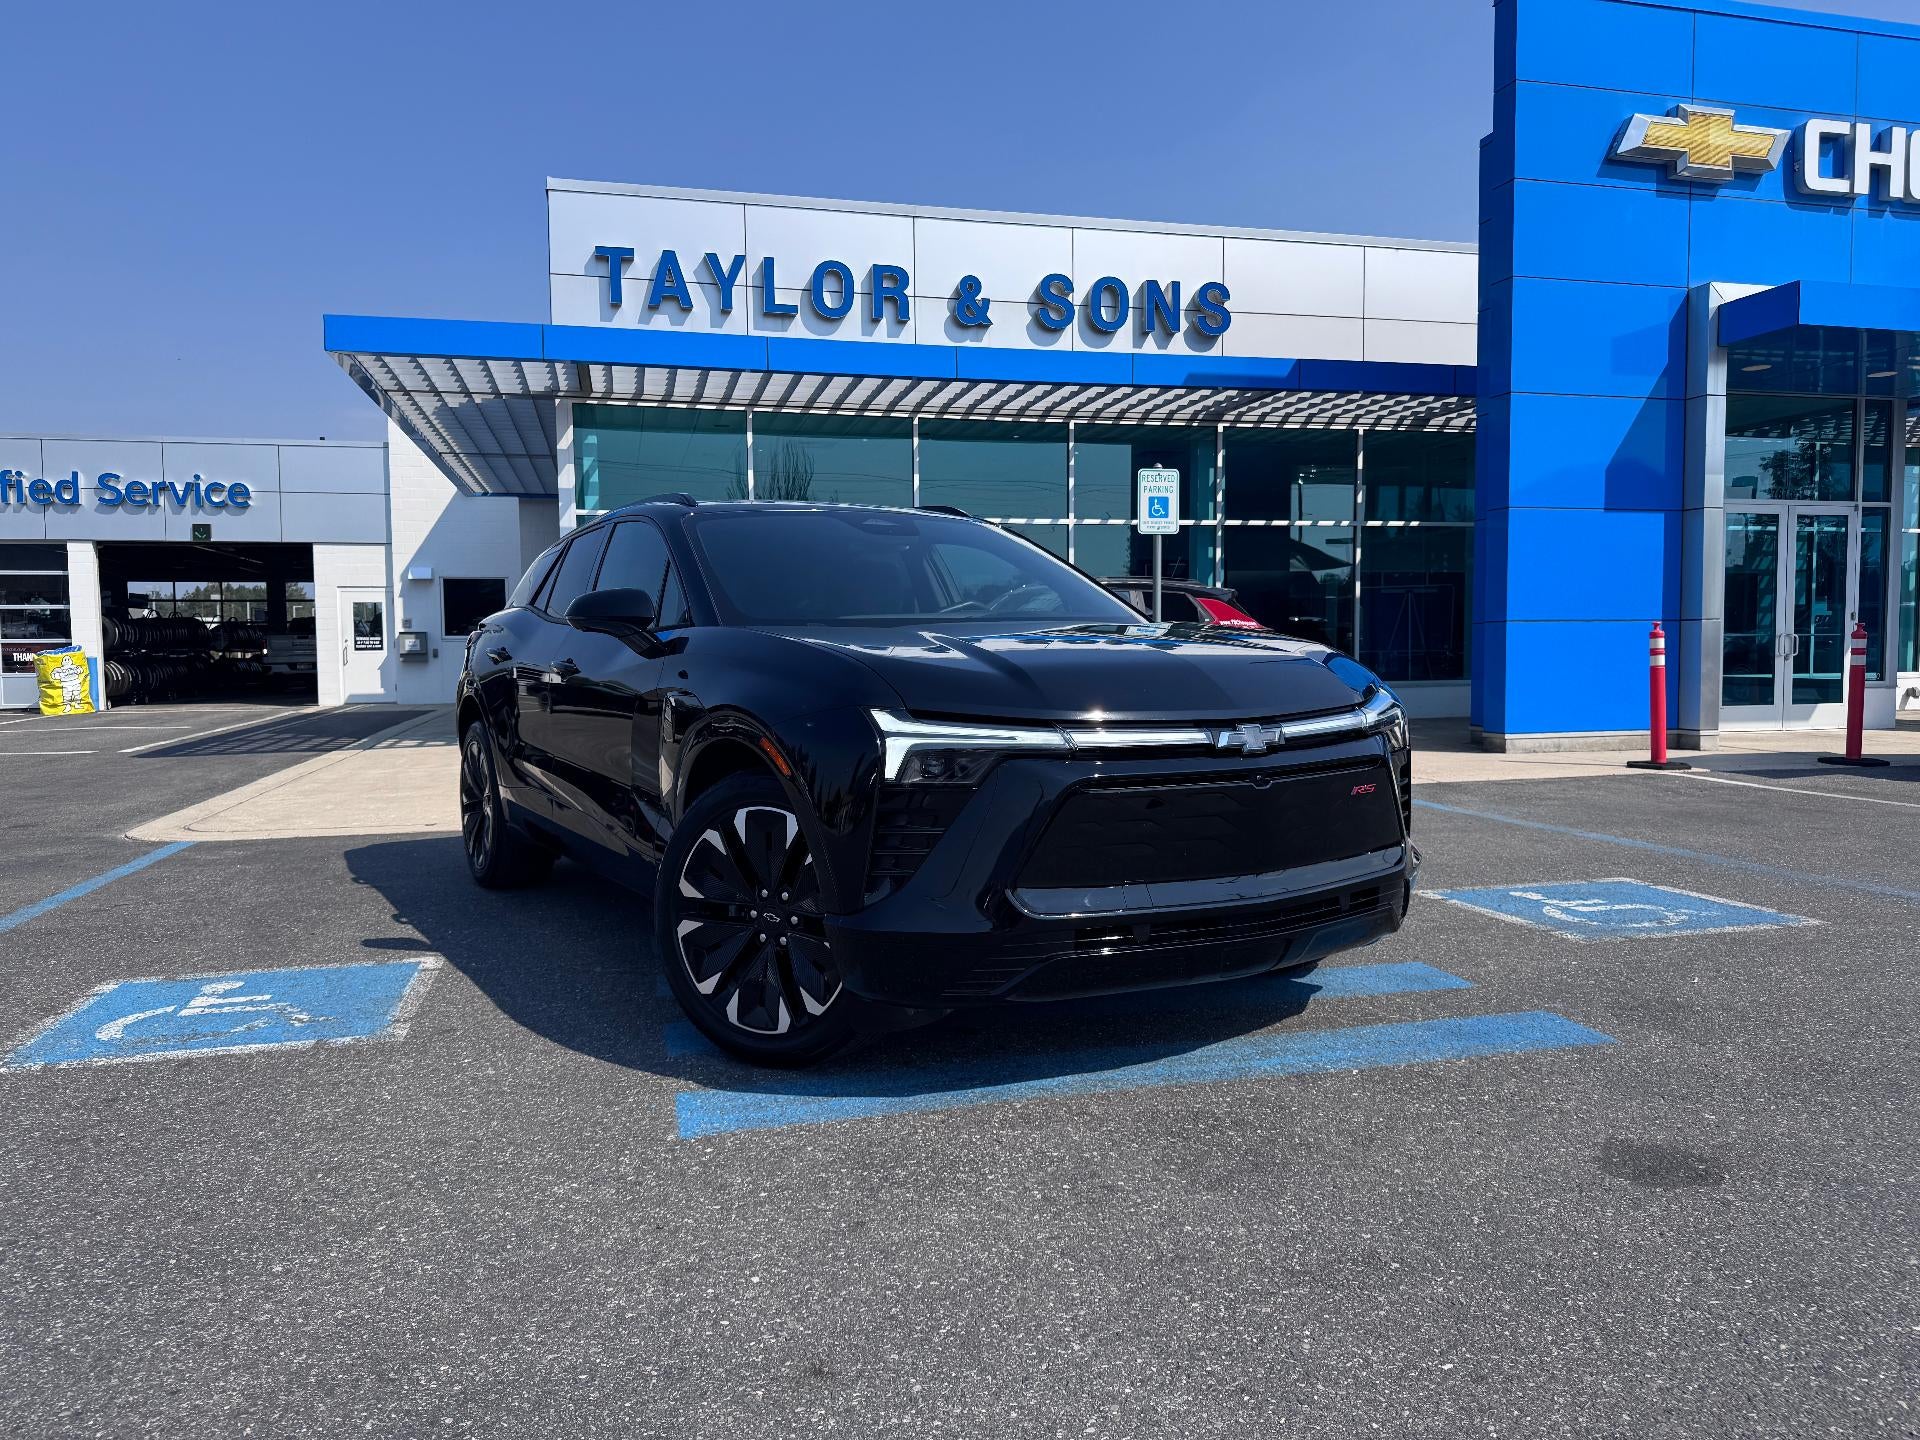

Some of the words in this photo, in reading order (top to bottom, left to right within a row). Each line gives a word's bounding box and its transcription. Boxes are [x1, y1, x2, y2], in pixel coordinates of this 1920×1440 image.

[1803, 118, 1920, 200] CH
[594, 246, 910, 323] TAYLOR
[953, 273, 994, 328] &
[1037, 272, 1232, 337] SONS
[0, 469, 81, 505] fied
[97, 472, 252, 508] Service
[1141, 474, 1176, 483] RESERVED
[1143, 485, 1174, 494] PARKING
[1350, 783, 1377, 796] RS
